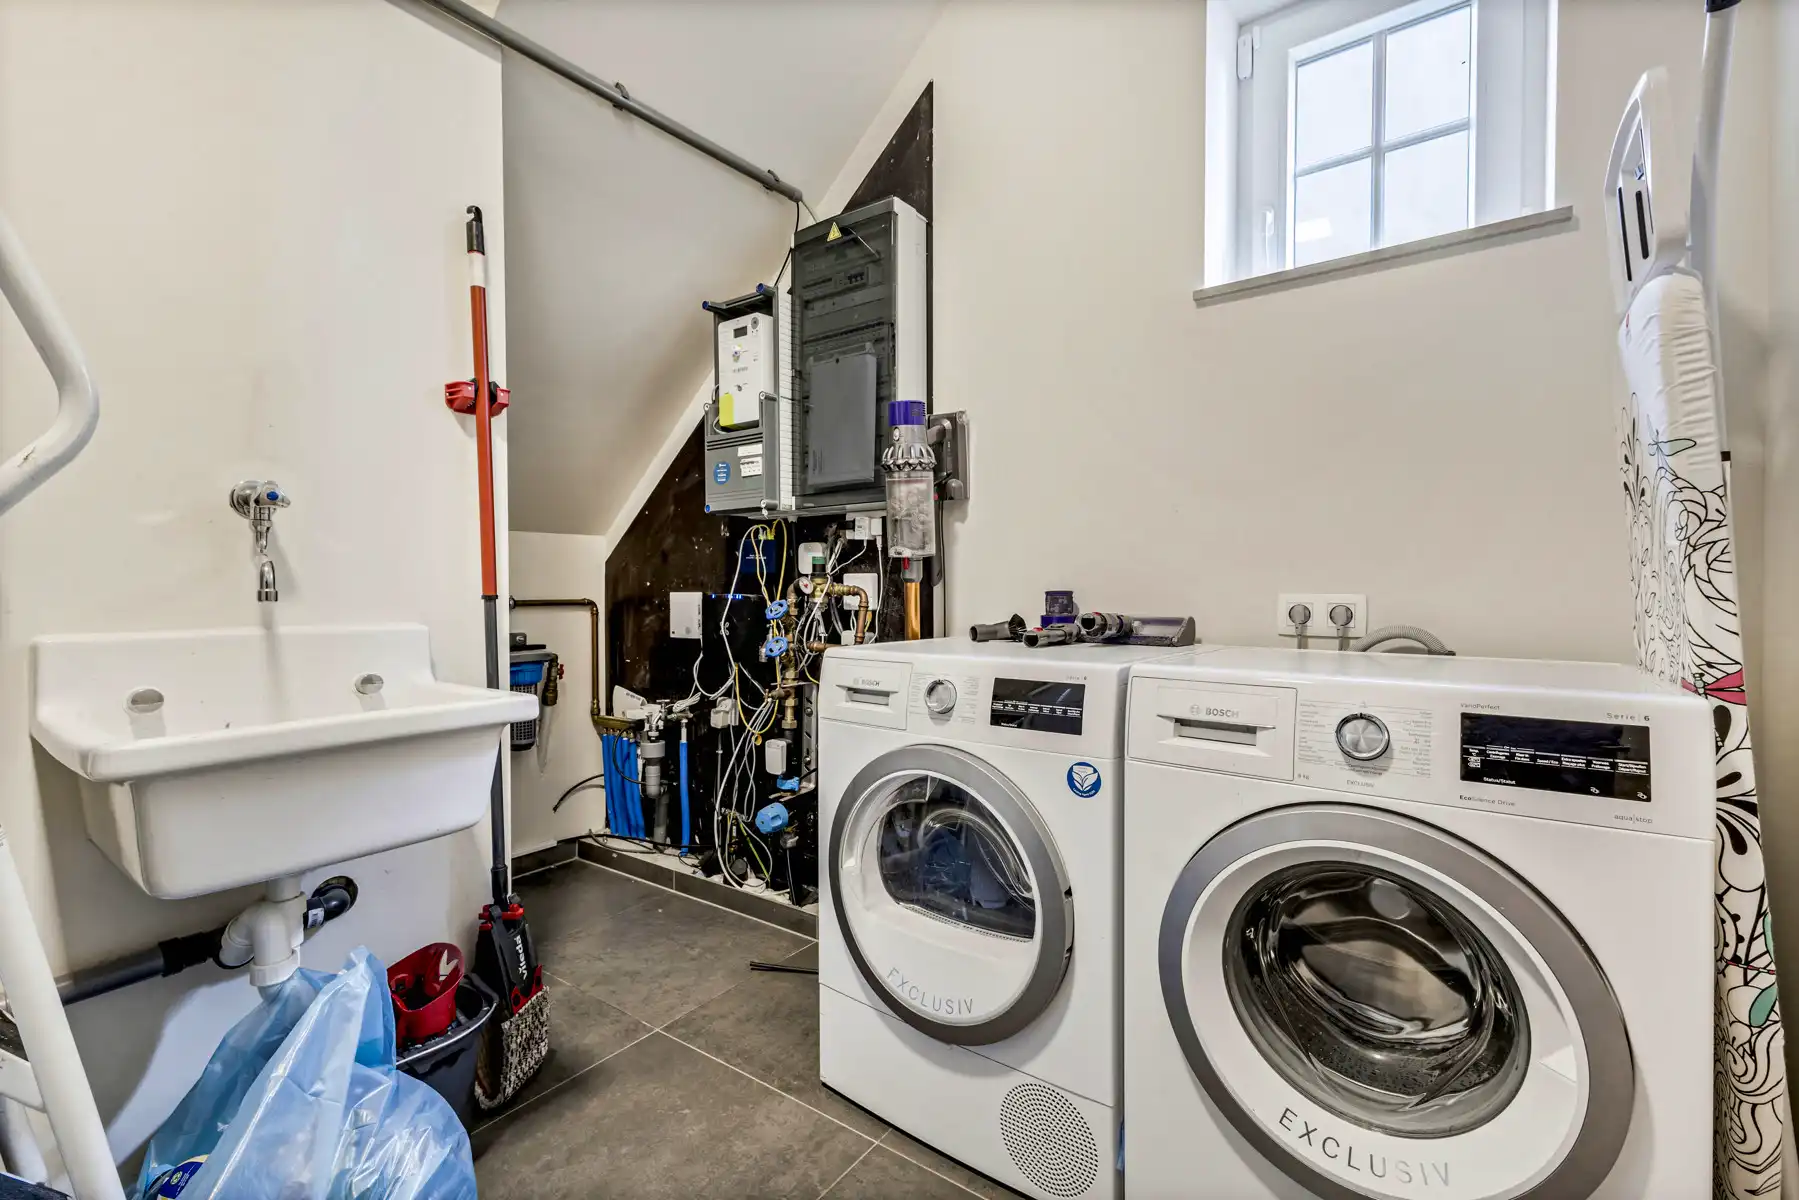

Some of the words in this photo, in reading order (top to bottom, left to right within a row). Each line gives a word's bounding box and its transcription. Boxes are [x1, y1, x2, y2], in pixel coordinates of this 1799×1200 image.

[861, 679, 880, 687] BOSCH
[1205, 707, 1239, 719] BOSCH
[1606, 712, 1635, 721] Serie
[886, 966, 974, 1016] EXCLUSIV
[1278, 1107, 1450, 1187] EXCLUSIV
